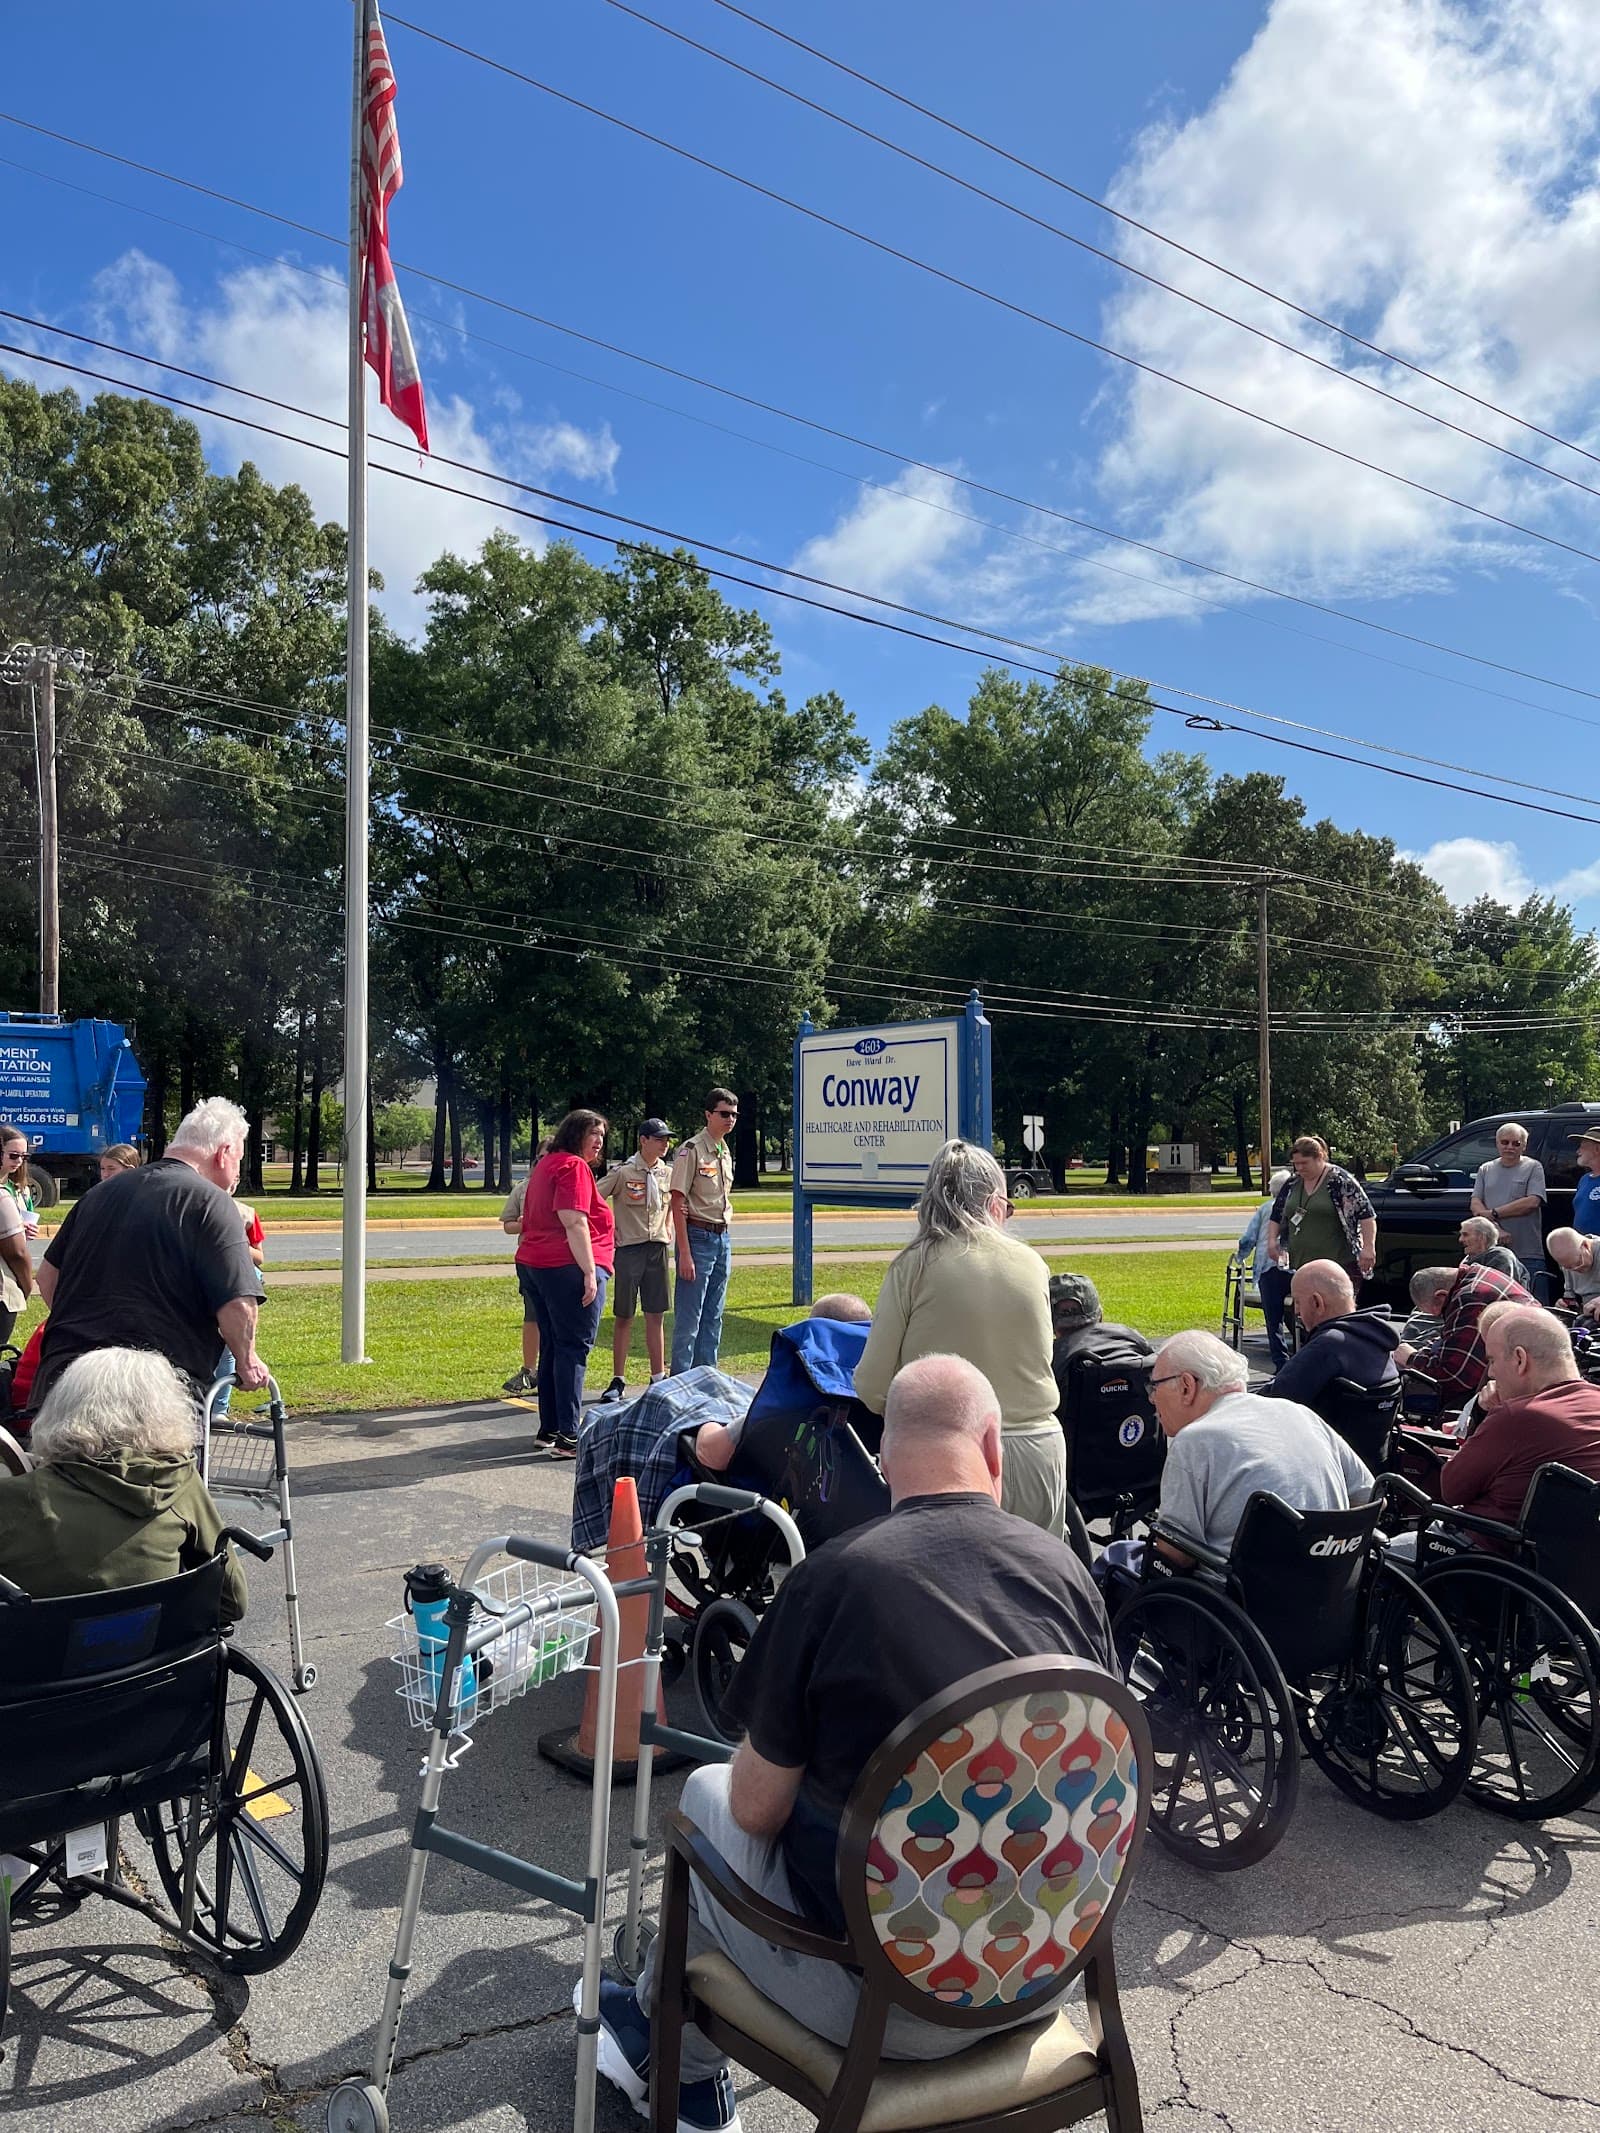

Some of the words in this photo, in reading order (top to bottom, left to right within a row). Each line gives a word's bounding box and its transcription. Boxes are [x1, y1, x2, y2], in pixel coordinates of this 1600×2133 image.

[859, 1040, 881, 1054] 2603
[846, 1058, 861, 1067] Dave
[864, 1057, 882, 1066] Ward
[885, 1055, 896, 1064] Dr.
[11, 1075, 51, 1084] ARKANSAS
[822, 1074, 920, 1113] Conway
[805, 1121, 853, 1134] HEALTHCARE
[853, 1120, 872, 1133] AND
[872, 1119, 943, 1132] REHABILITATION
[853, 1135, 885, 1147] CENTER
[1100, 1385, 1129, 1394] QUICKIE
[1309, 1535, 1363, 1556] drive
[1428, 1541, 1457, 1556] drive
